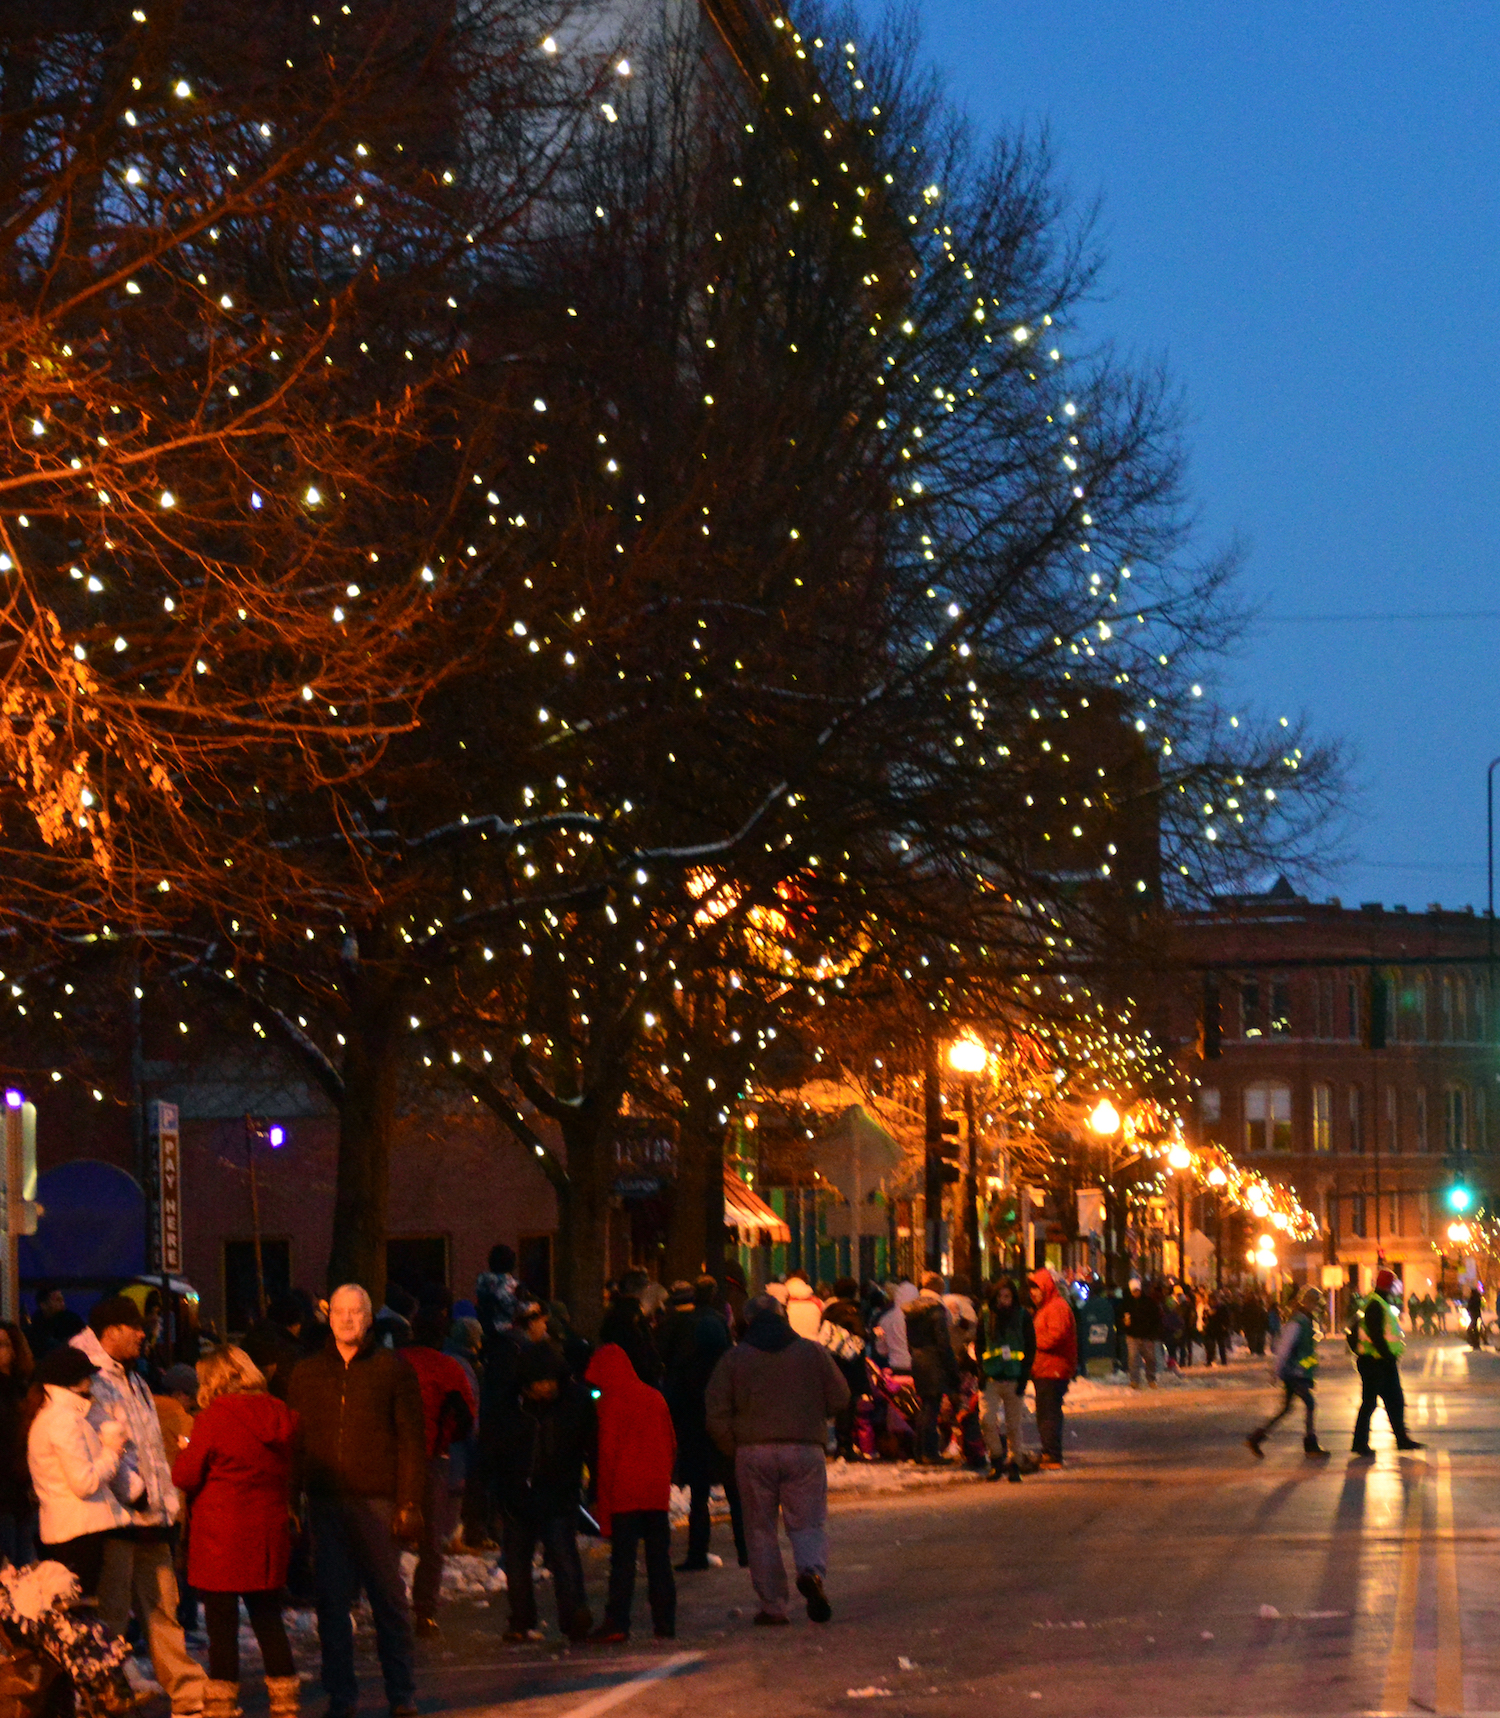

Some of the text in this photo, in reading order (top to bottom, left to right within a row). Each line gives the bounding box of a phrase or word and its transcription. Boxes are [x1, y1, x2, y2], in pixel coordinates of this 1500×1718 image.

[163, 1108, 174, 1129] P
[164, 1140, 178, 1265] PAY HERE
